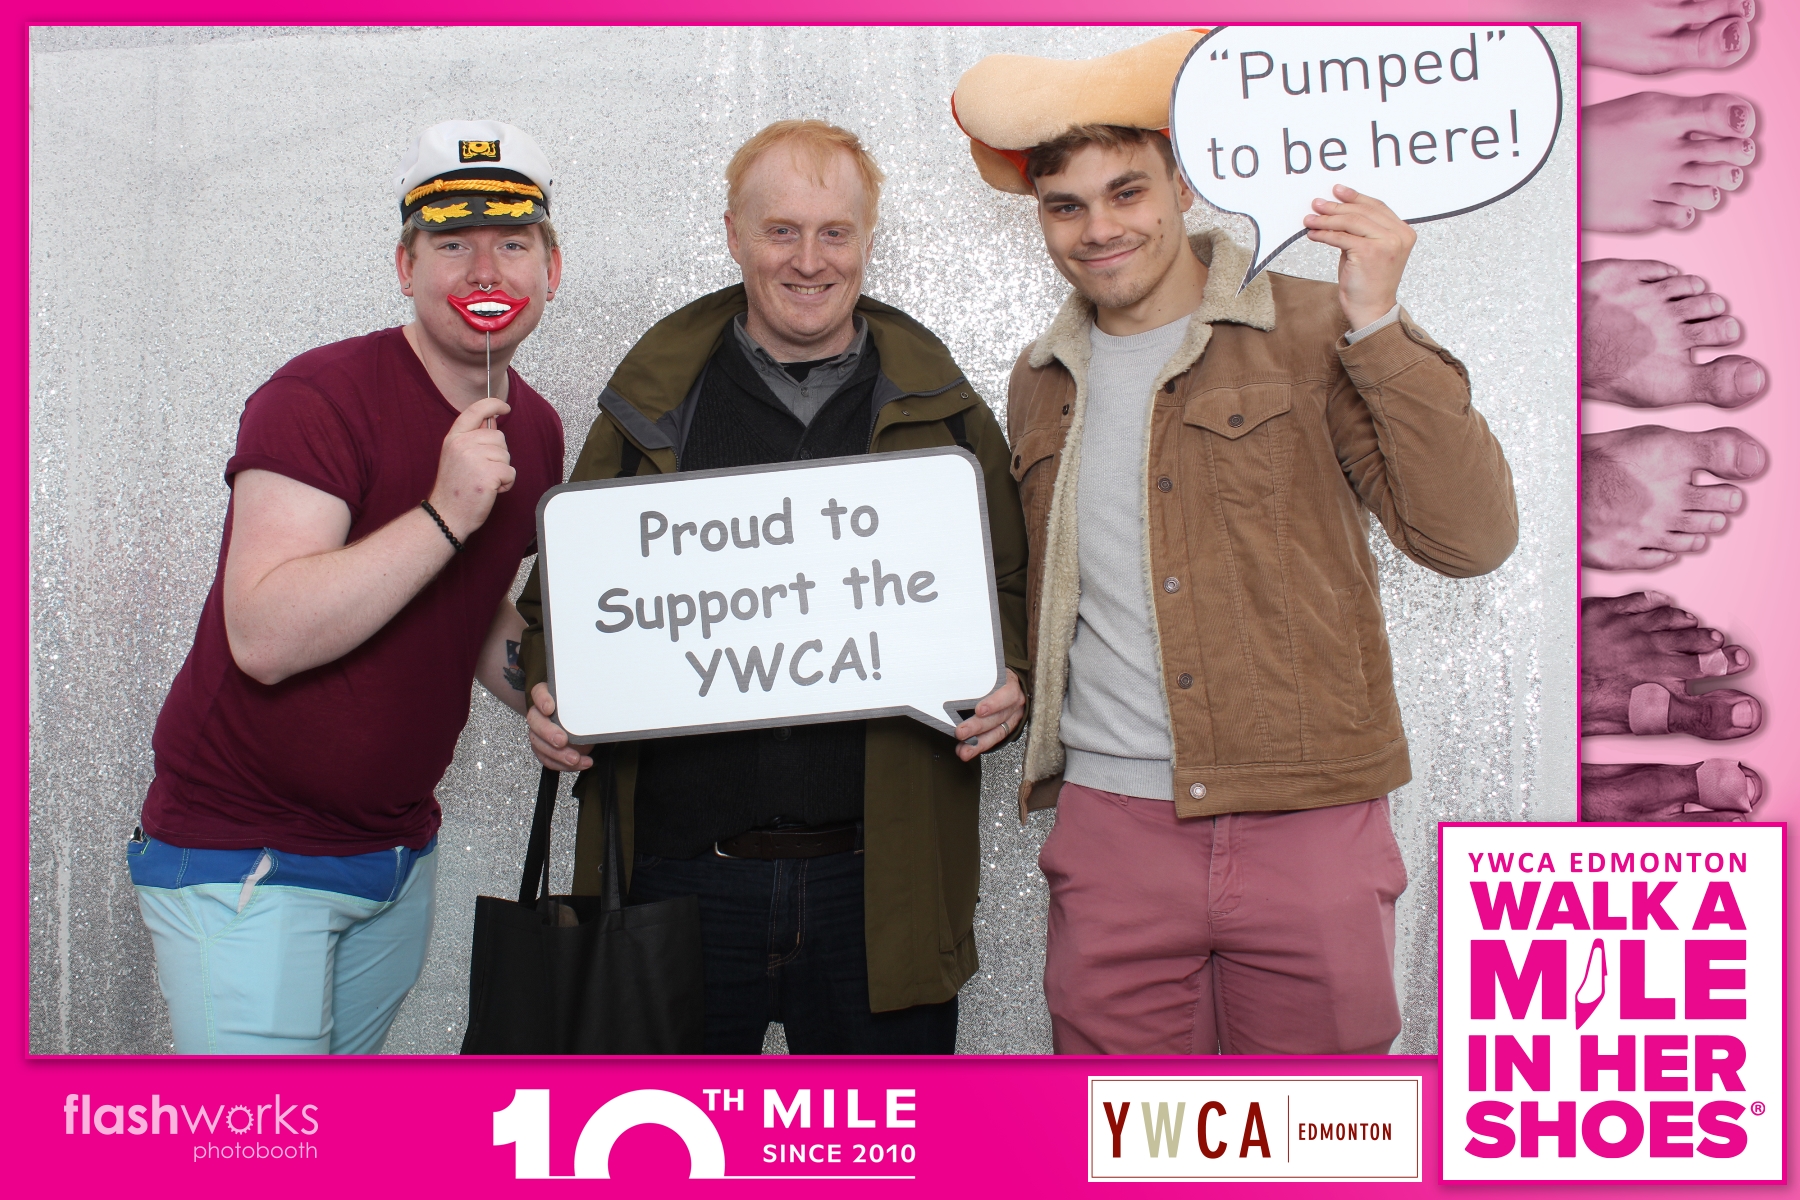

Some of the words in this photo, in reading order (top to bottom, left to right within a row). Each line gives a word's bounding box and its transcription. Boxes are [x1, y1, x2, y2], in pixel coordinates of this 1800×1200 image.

[1206, 136, 1260, 180] to
[1282, 127, 1348, 175] be
[1371, 108, 1522, 168] here!
[639, 496, 794, 558] Proud
[820, 498, 879, 540] to
[595, 572, 816, 643] Support
[842, 559, 939, 611] the
[685, 631, 882, 698] YWCA!
